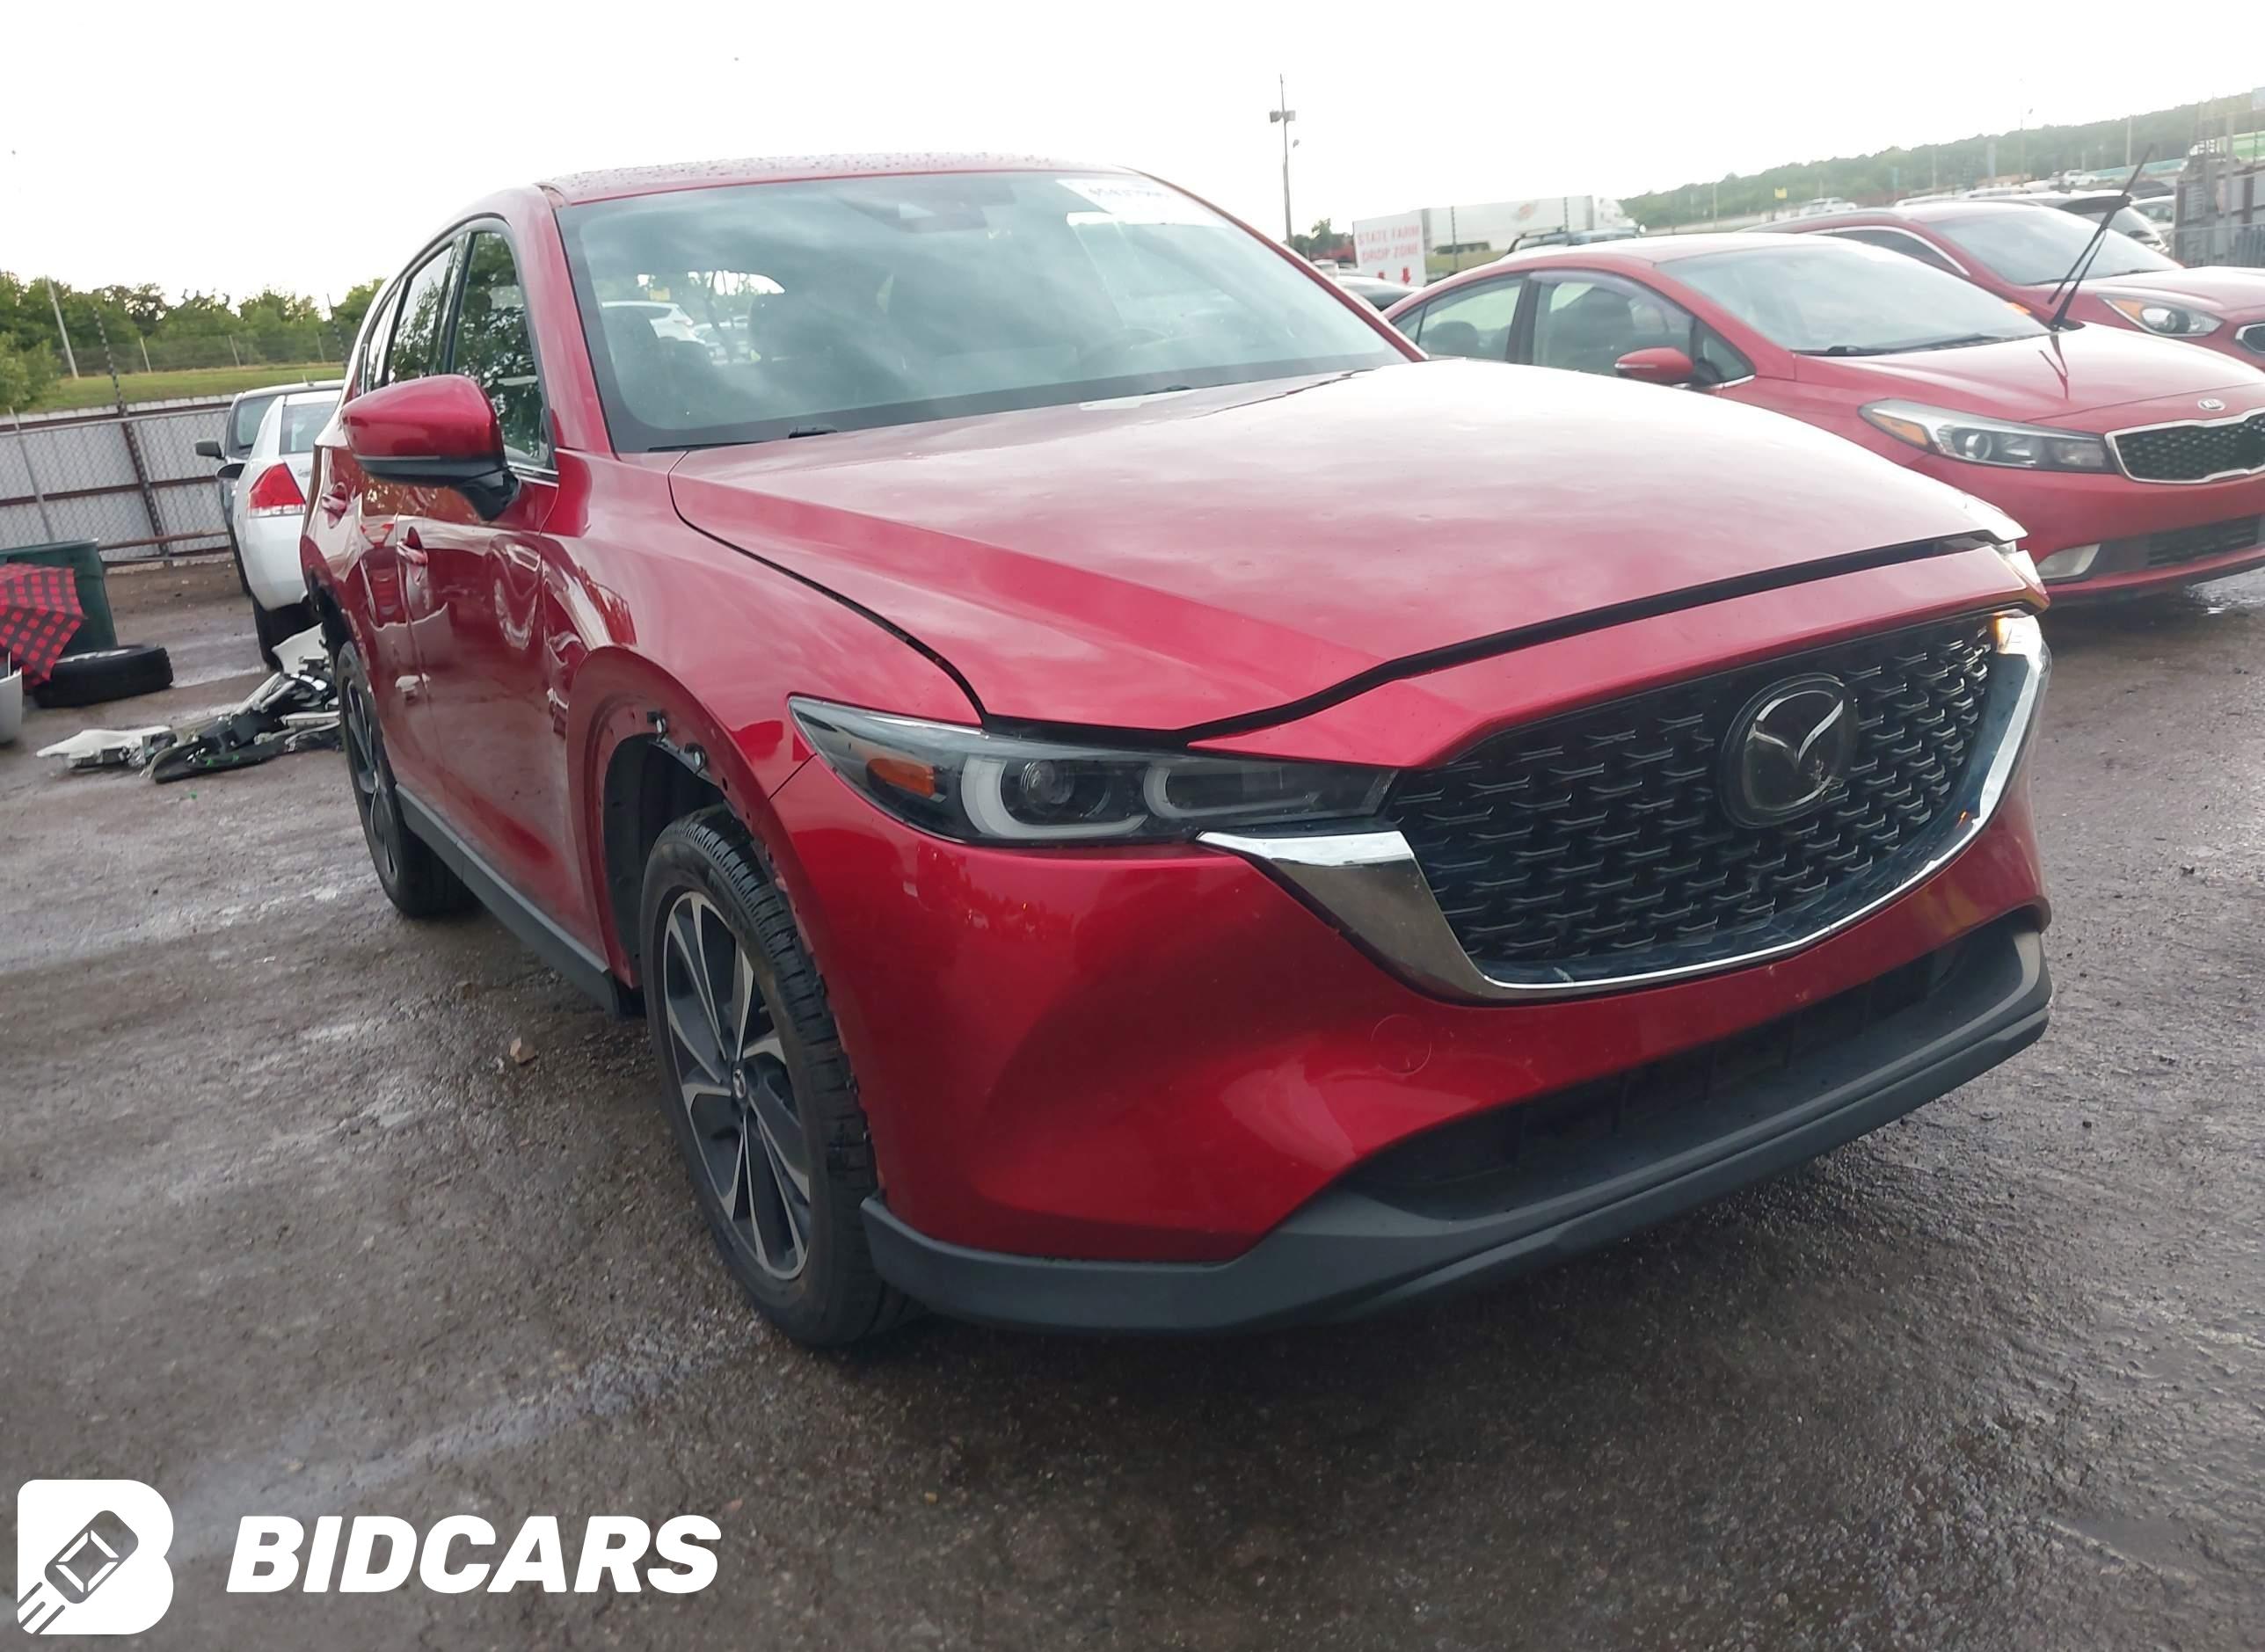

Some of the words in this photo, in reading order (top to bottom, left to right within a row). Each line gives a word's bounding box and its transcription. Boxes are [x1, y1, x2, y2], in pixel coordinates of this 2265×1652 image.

[1358, 229, 1387, 245] STATE
[1361, 247, 1389, 263] DROP
[1393, 243, 1418, 258] ZONE
